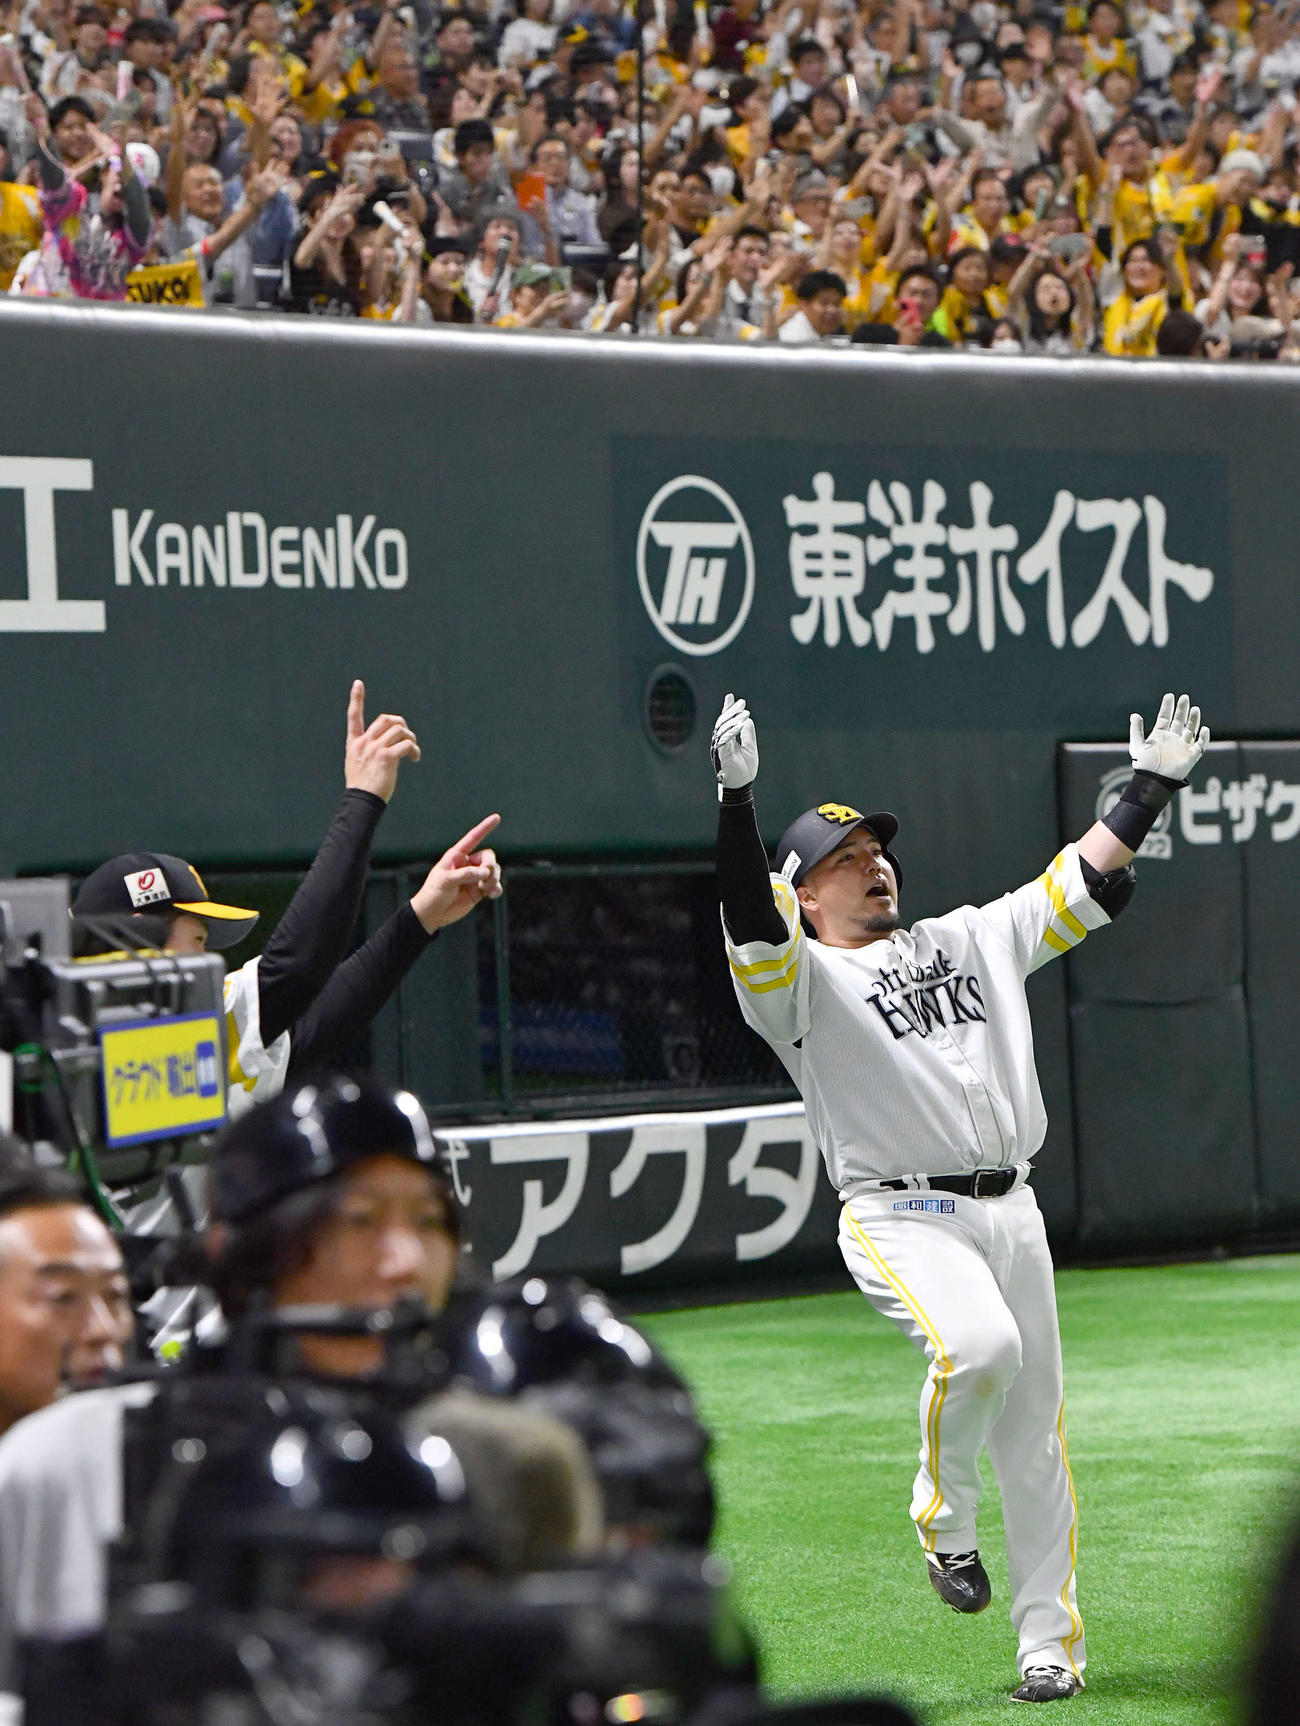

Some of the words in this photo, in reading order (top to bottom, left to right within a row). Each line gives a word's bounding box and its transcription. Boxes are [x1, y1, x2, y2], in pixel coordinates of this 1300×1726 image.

[783, 471, 1214, 654] 東洋ホイスト
